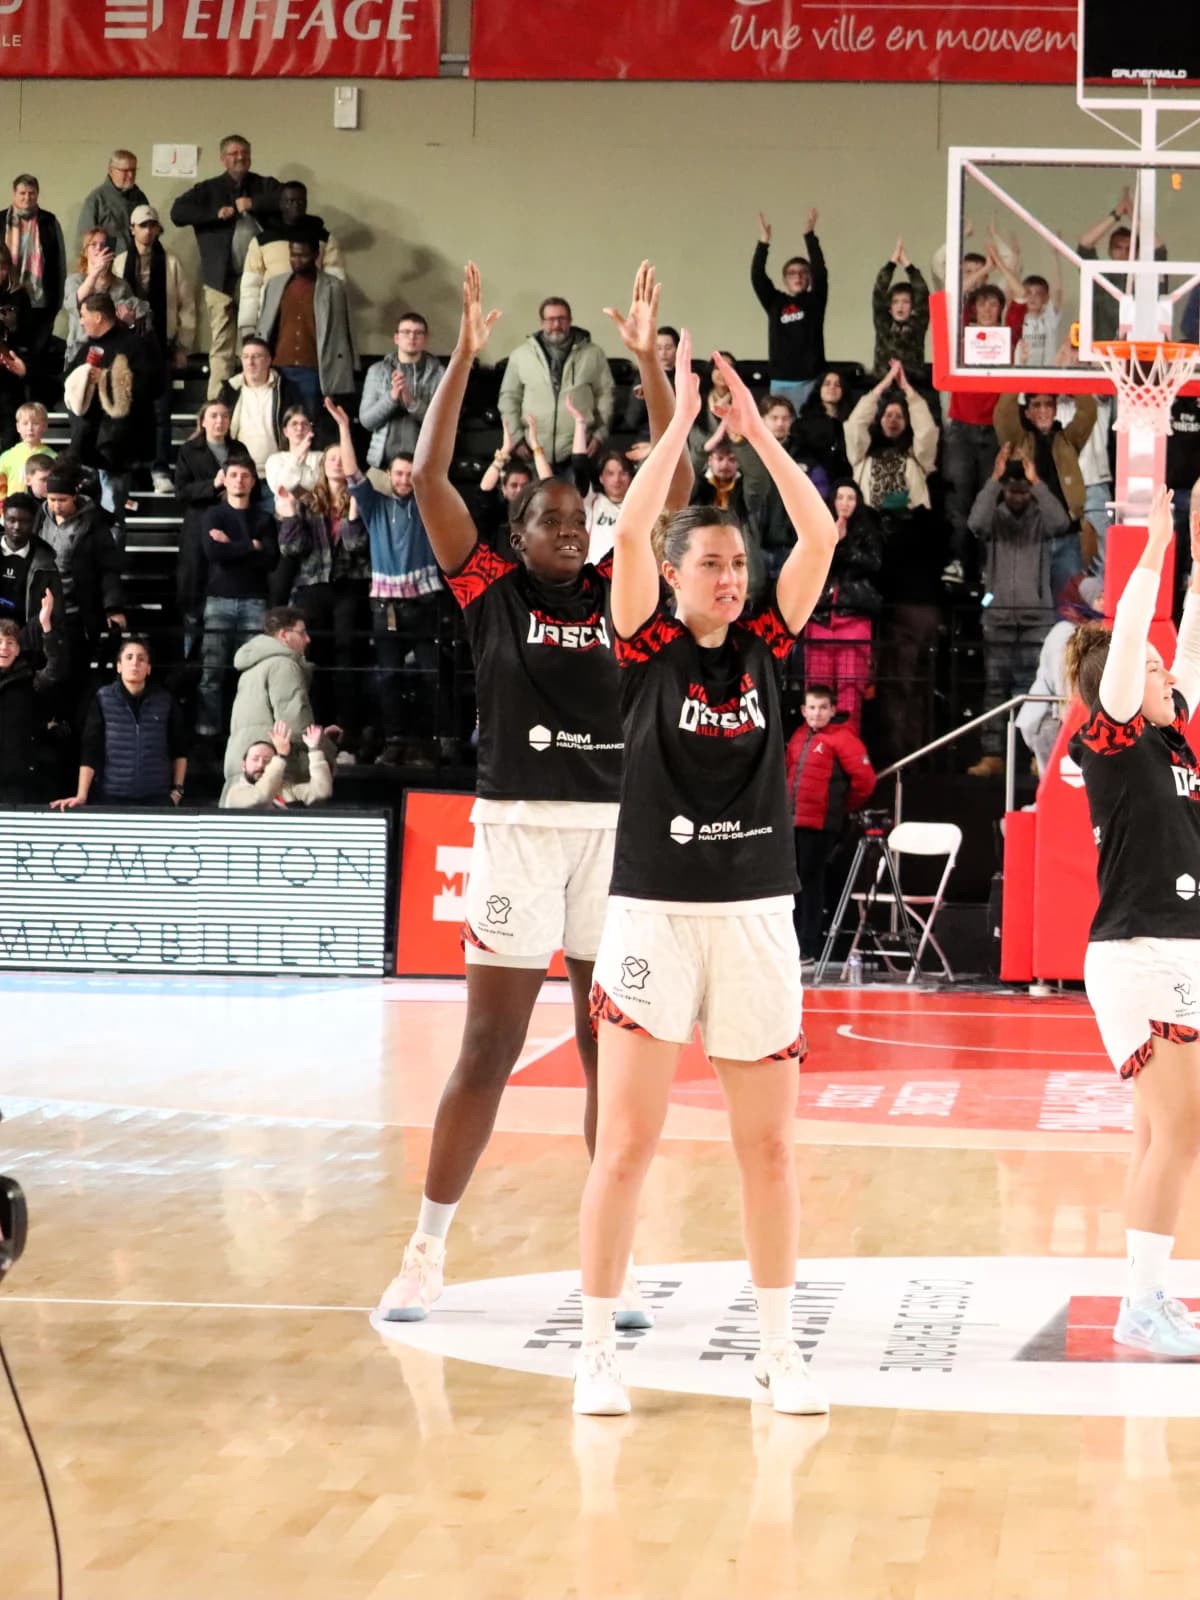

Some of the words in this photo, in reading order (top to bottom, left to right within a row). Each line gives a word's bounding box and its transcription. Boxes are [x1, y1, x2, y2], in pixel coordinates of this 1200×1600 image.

[182, 0, 414, 40] EIFFAGE
[729, 14, 802, 51] Une
[812, 15, 875, 51] ville
[886, 25, 927, 51] en
[556, 730, 591, 743] ADIM
[699, 820, 740, 834] ADIM
